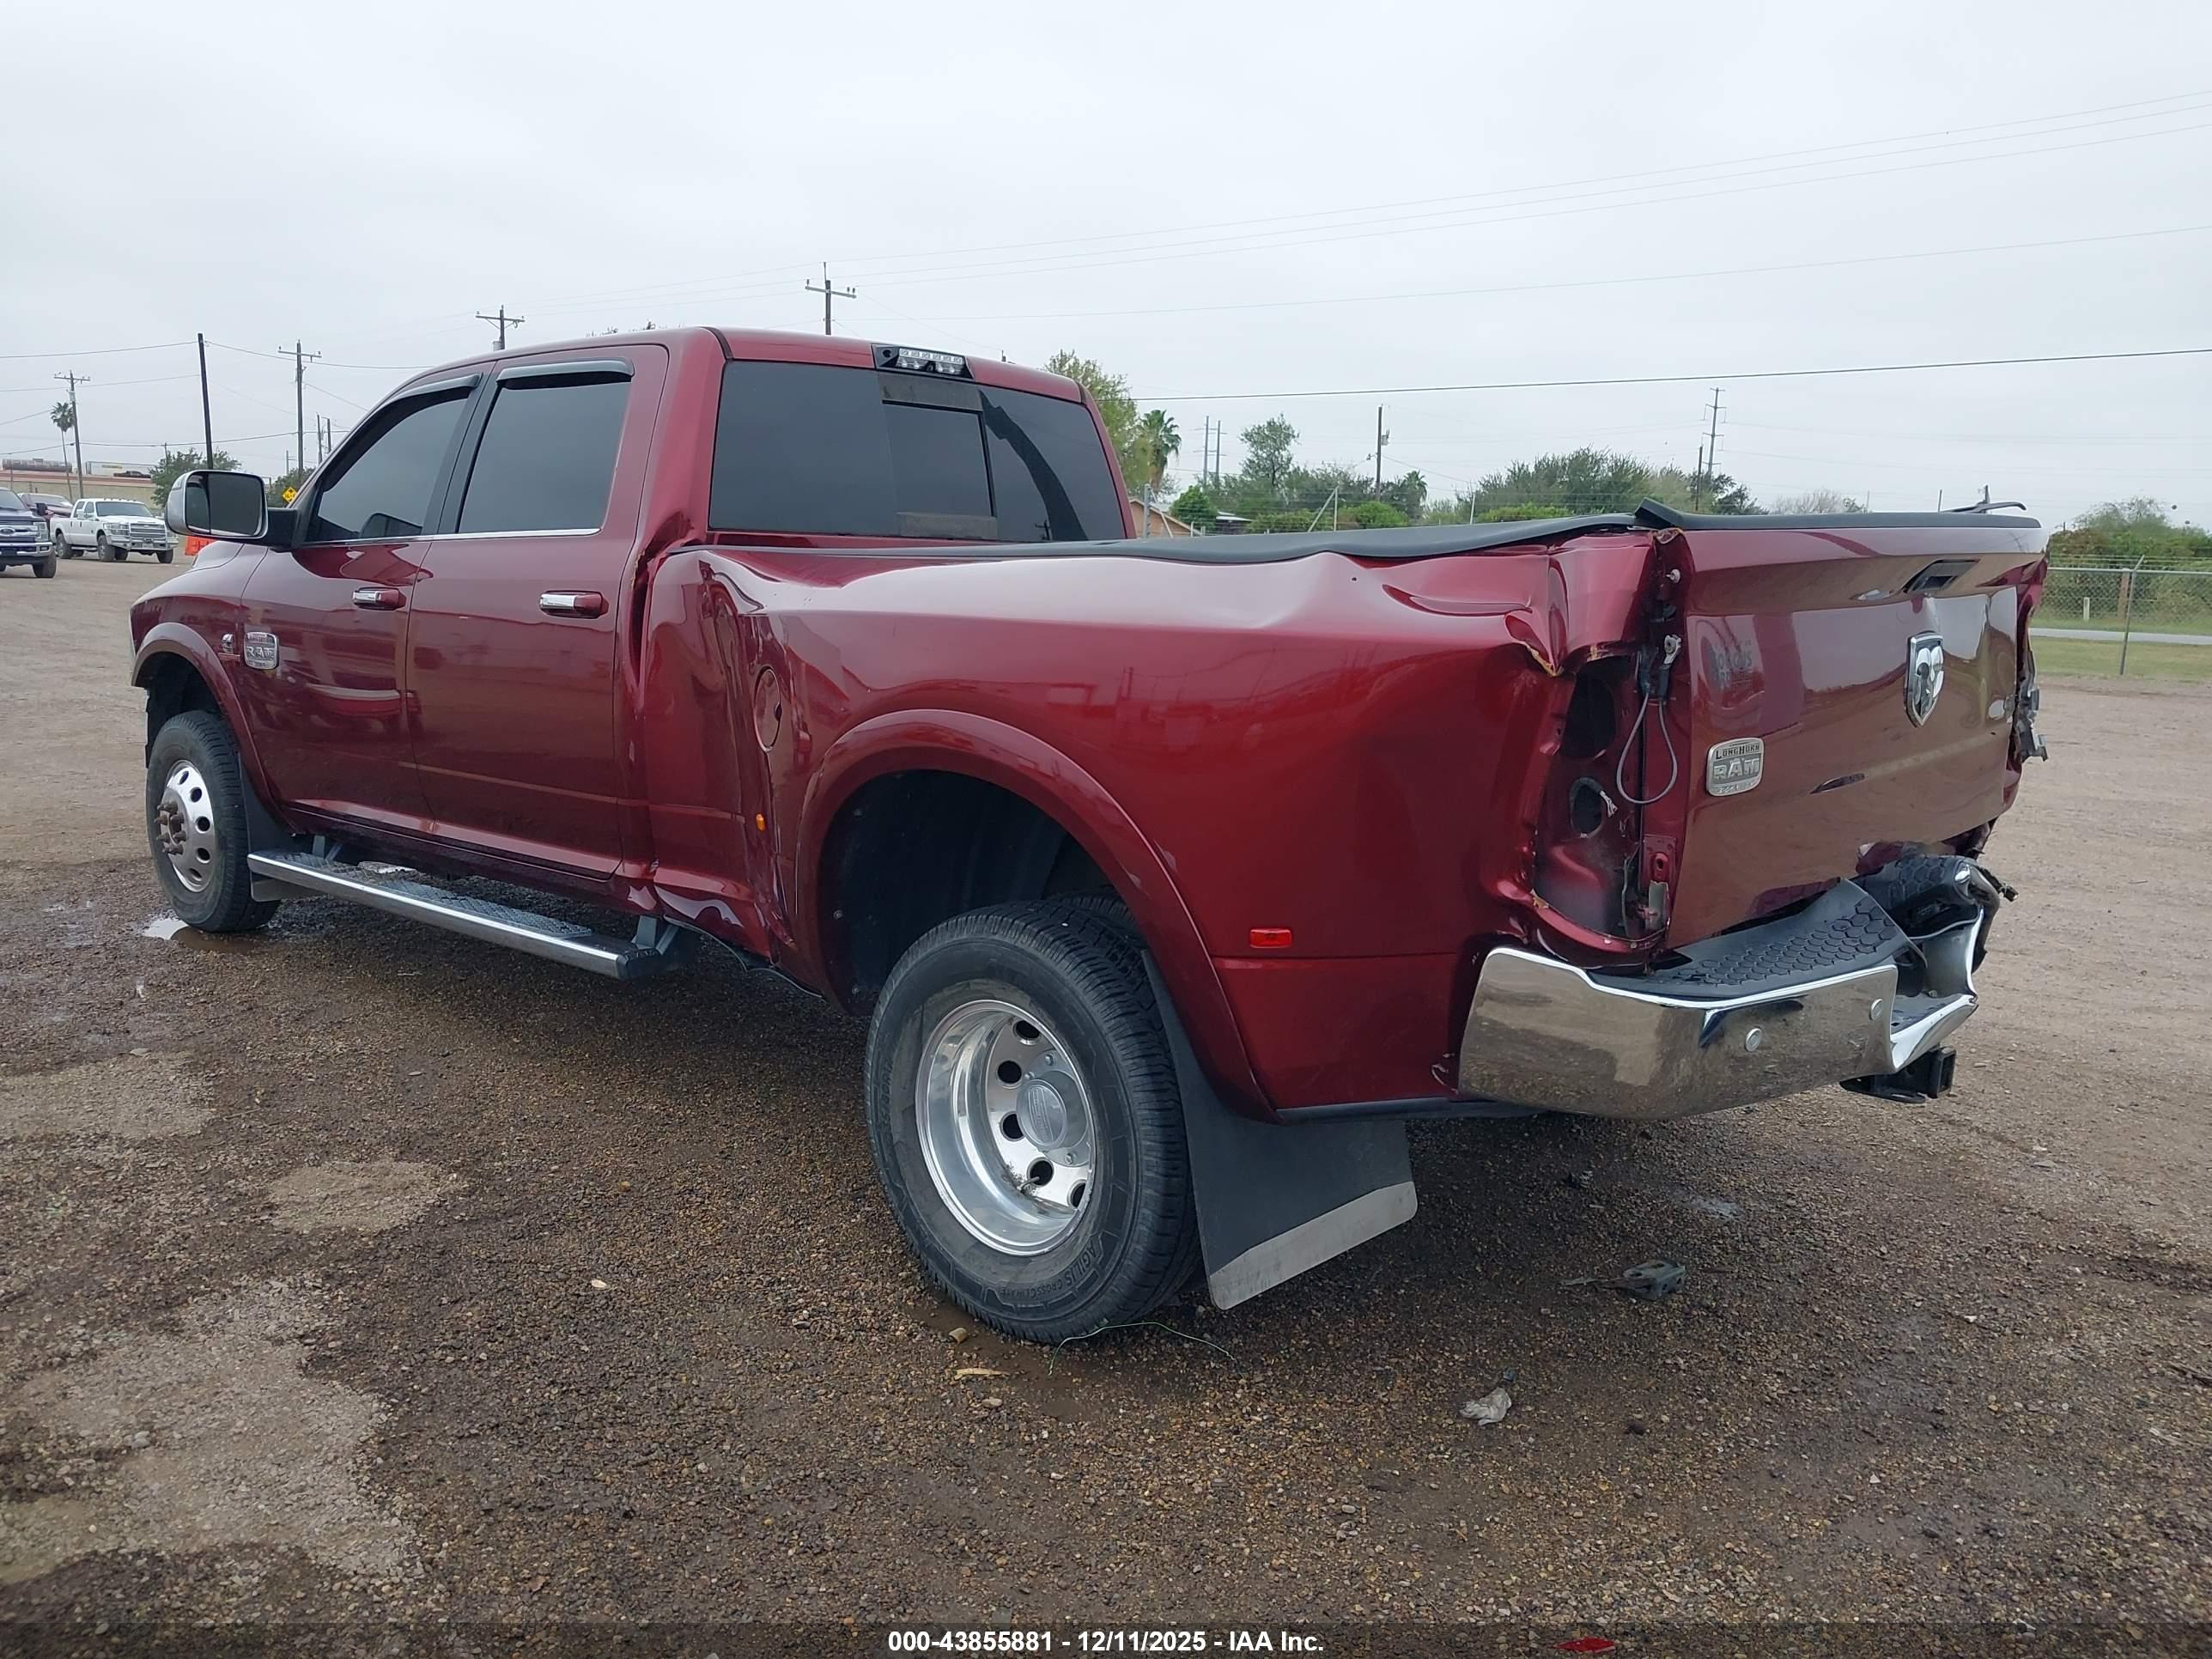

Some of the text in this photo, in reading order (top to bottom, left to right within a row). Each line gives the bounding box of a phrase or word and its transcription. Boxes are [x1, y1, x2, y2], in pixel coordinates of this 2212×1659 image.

[1715, 744, 1760, 760] LONGHORN
[1713, 758, 1760, 780] RAM
[1064, 1239, 1097, 1286] AGILIS
